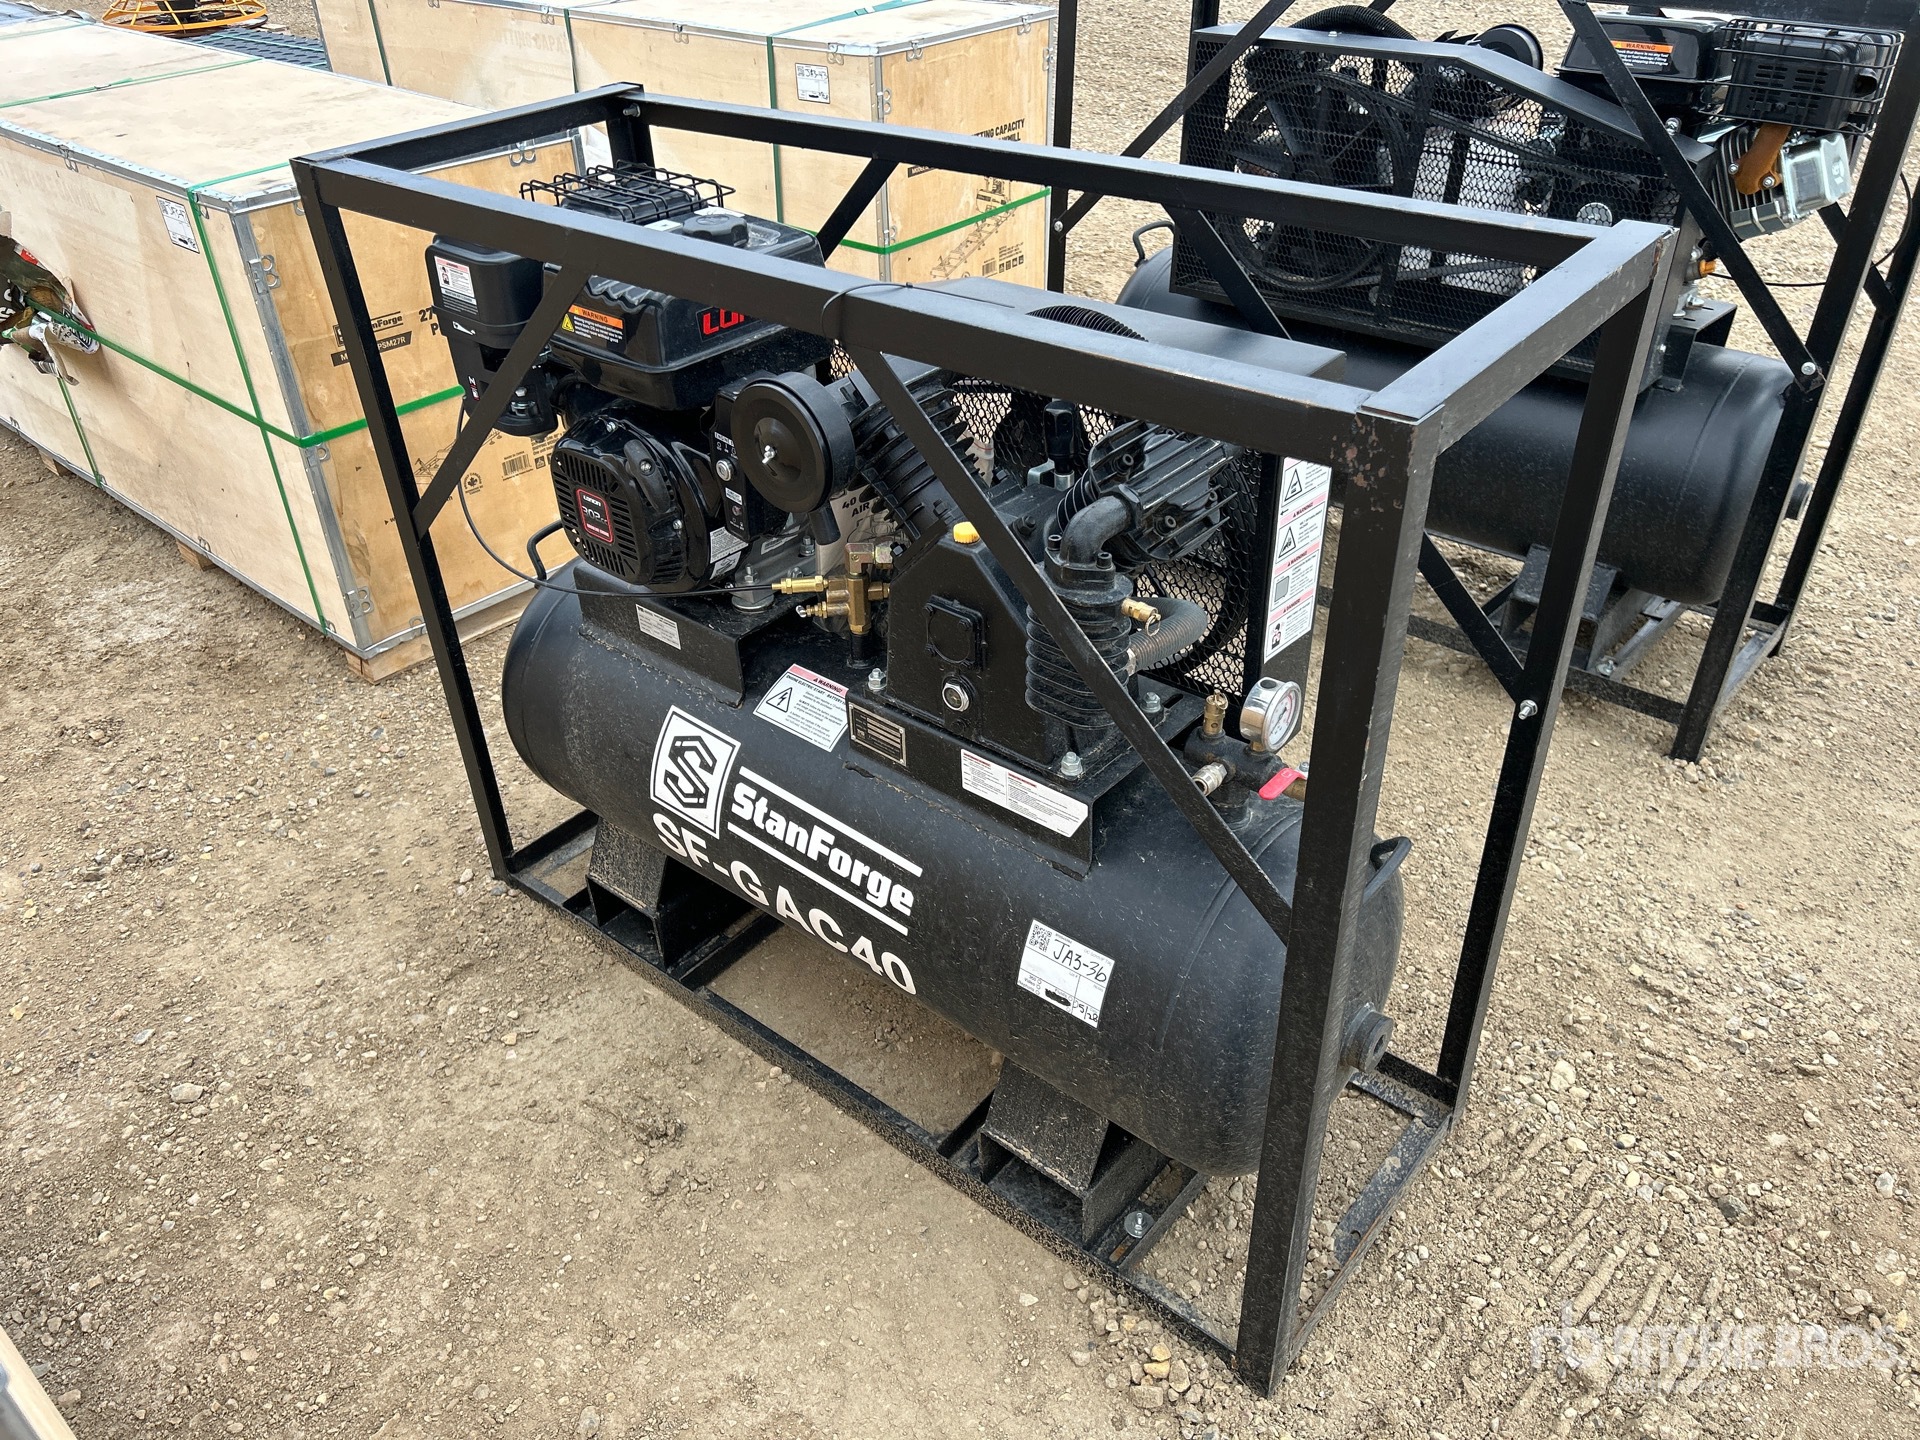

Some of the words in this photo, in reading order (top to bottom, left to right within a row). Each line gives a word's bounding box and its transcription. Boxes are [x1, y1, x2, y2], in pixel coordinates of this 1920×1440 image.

[994, 118, 1025, 136] CAPACITY
[371, 314, 403, 328] nForge
[582, 308, 608, 323] WARNING
[842, 496, 857, 509] 40
[851, 502, 870, 517] AIR
[731, 782, 914, 917] StanForge
